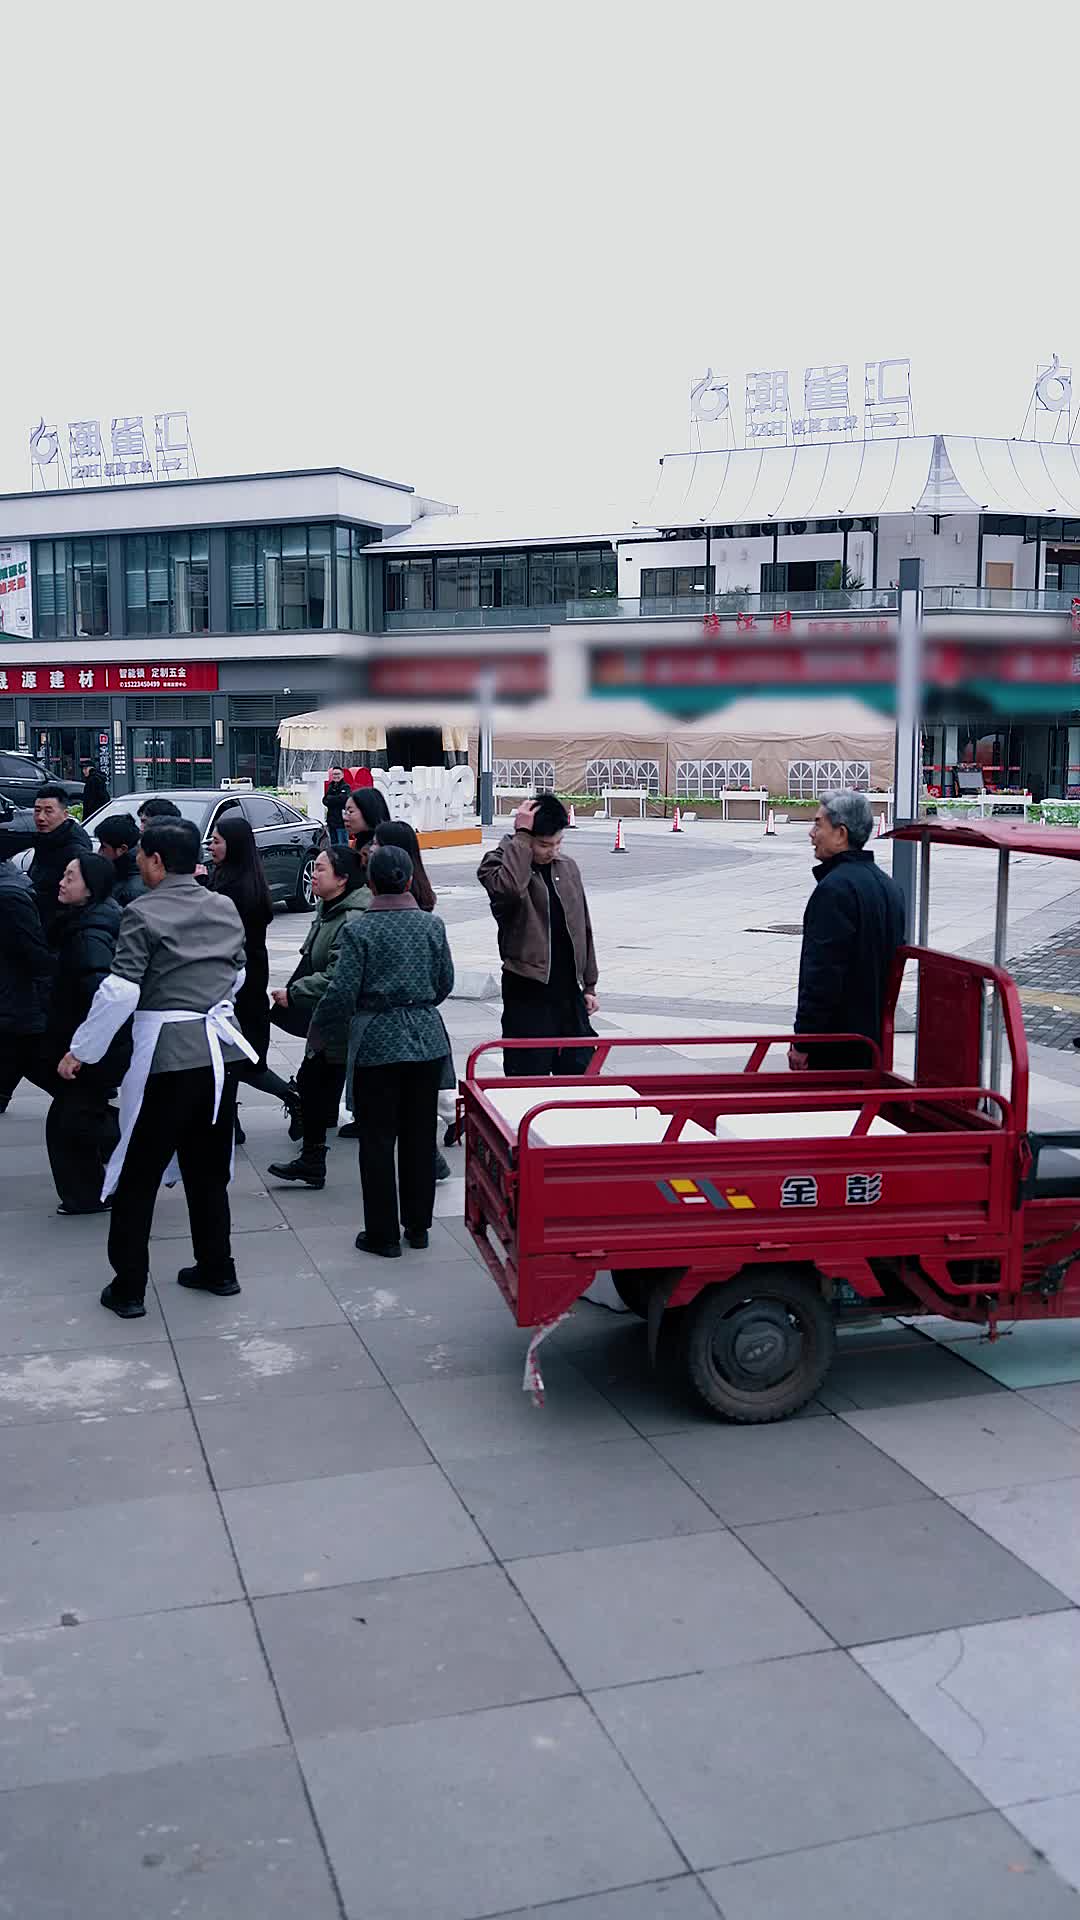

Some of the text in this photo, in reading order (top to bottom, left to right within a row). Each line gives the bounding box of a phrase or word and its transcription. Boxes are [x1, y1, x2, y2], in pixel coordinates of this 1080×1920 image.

[151, 667, 187, 678] 定制五金
[779, 1173, 883, 1208] 金彭
